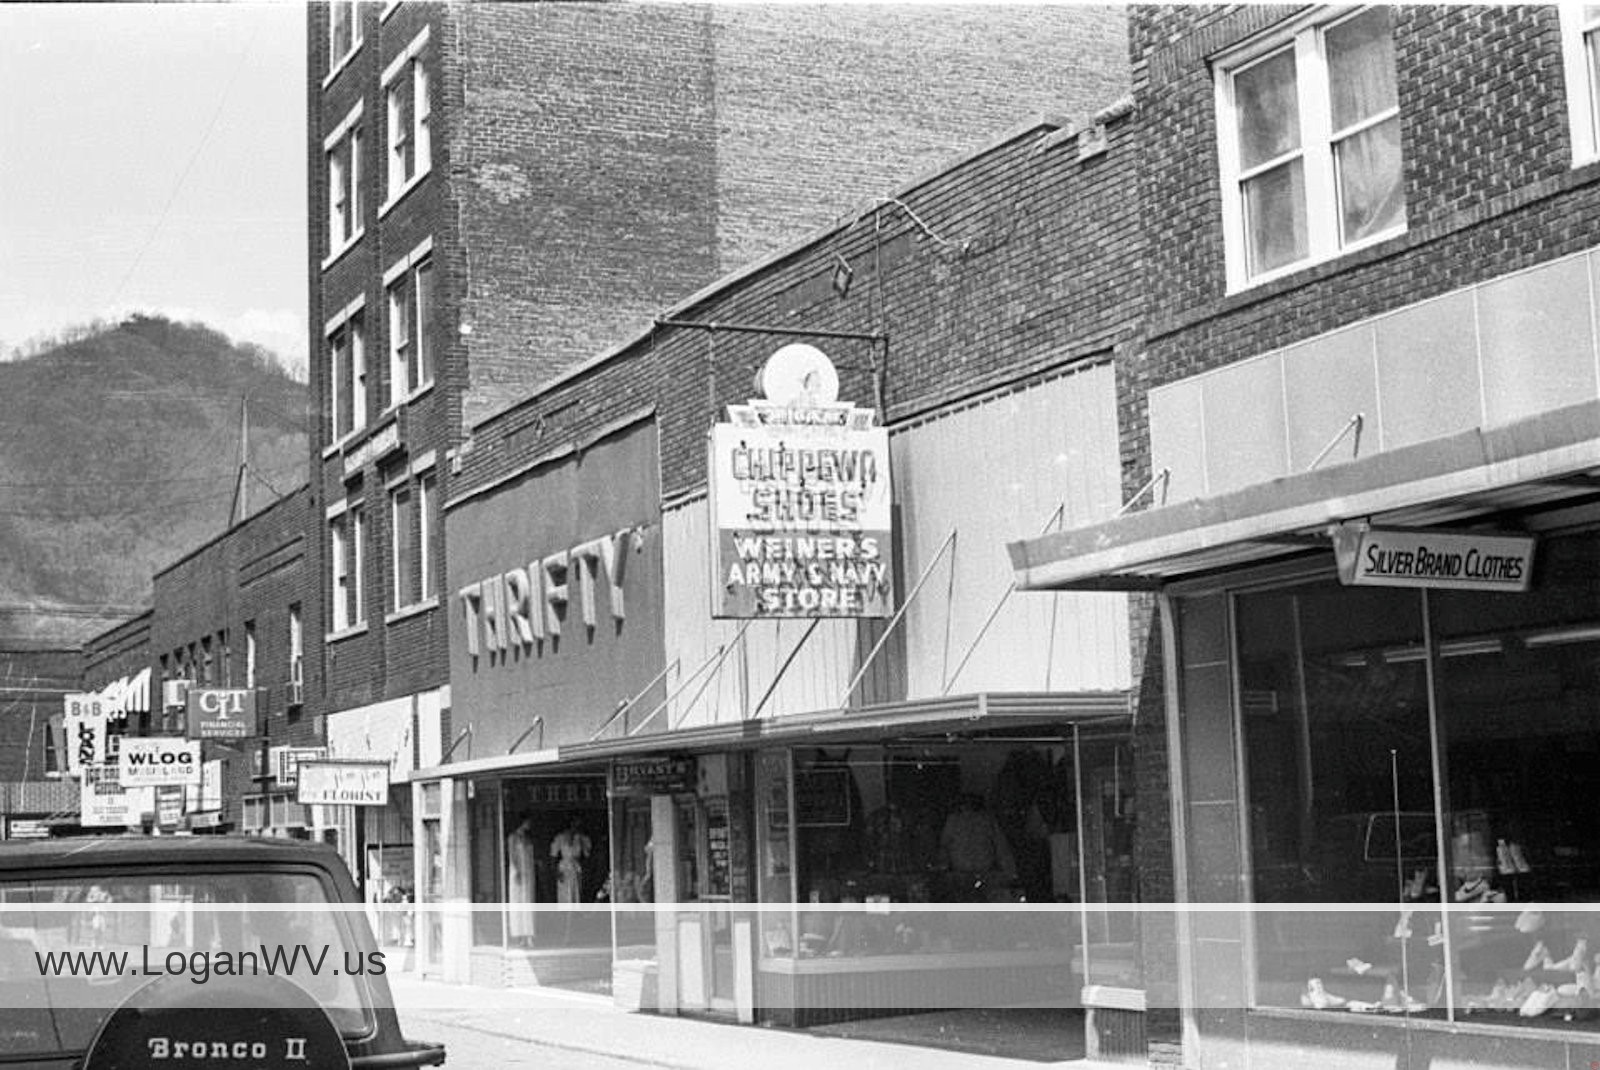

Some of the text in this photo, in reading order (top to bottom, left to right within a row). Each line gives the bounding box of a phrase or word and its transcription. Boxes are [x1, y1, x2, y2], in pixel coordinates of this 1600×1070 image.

[753, 490, 858, 522] SHOES
[1365, 545, 1523, 579] SILVER BRAND CLOTHES
[728, 563, 794, 585] ARMY
[829, 564, 887, 586] NAVY
[459, 528, 632, 656] THRIFTY
[761, 587, 857, 611] STORE
[127, 751, 193, 766] WLOG
[148, 1038, 268, 1060] Bronco
